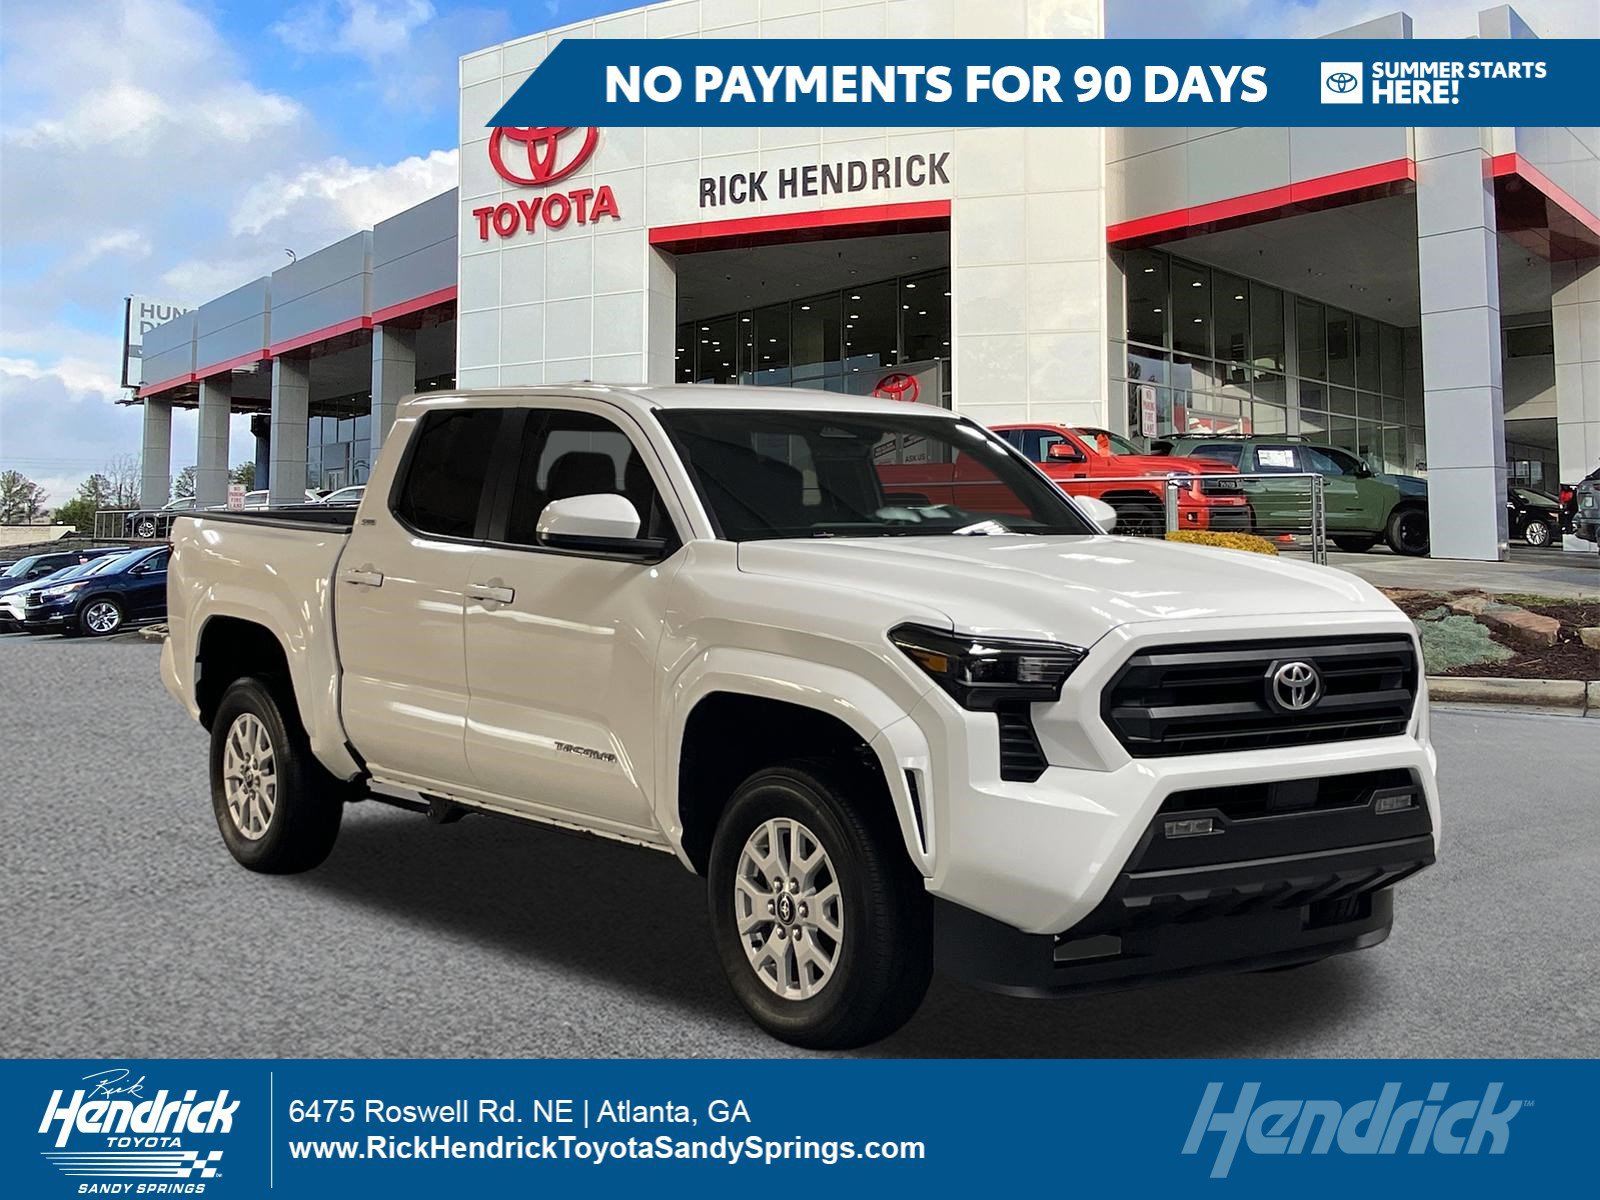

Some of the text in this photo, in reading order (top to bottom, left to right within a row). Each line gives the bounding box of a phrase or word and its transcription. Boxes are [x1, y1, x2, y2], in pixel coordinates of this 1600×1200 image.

[700, 152, 950, 208] RICK HENDRICK
[473, 185, 620, 240] TOYOTA
